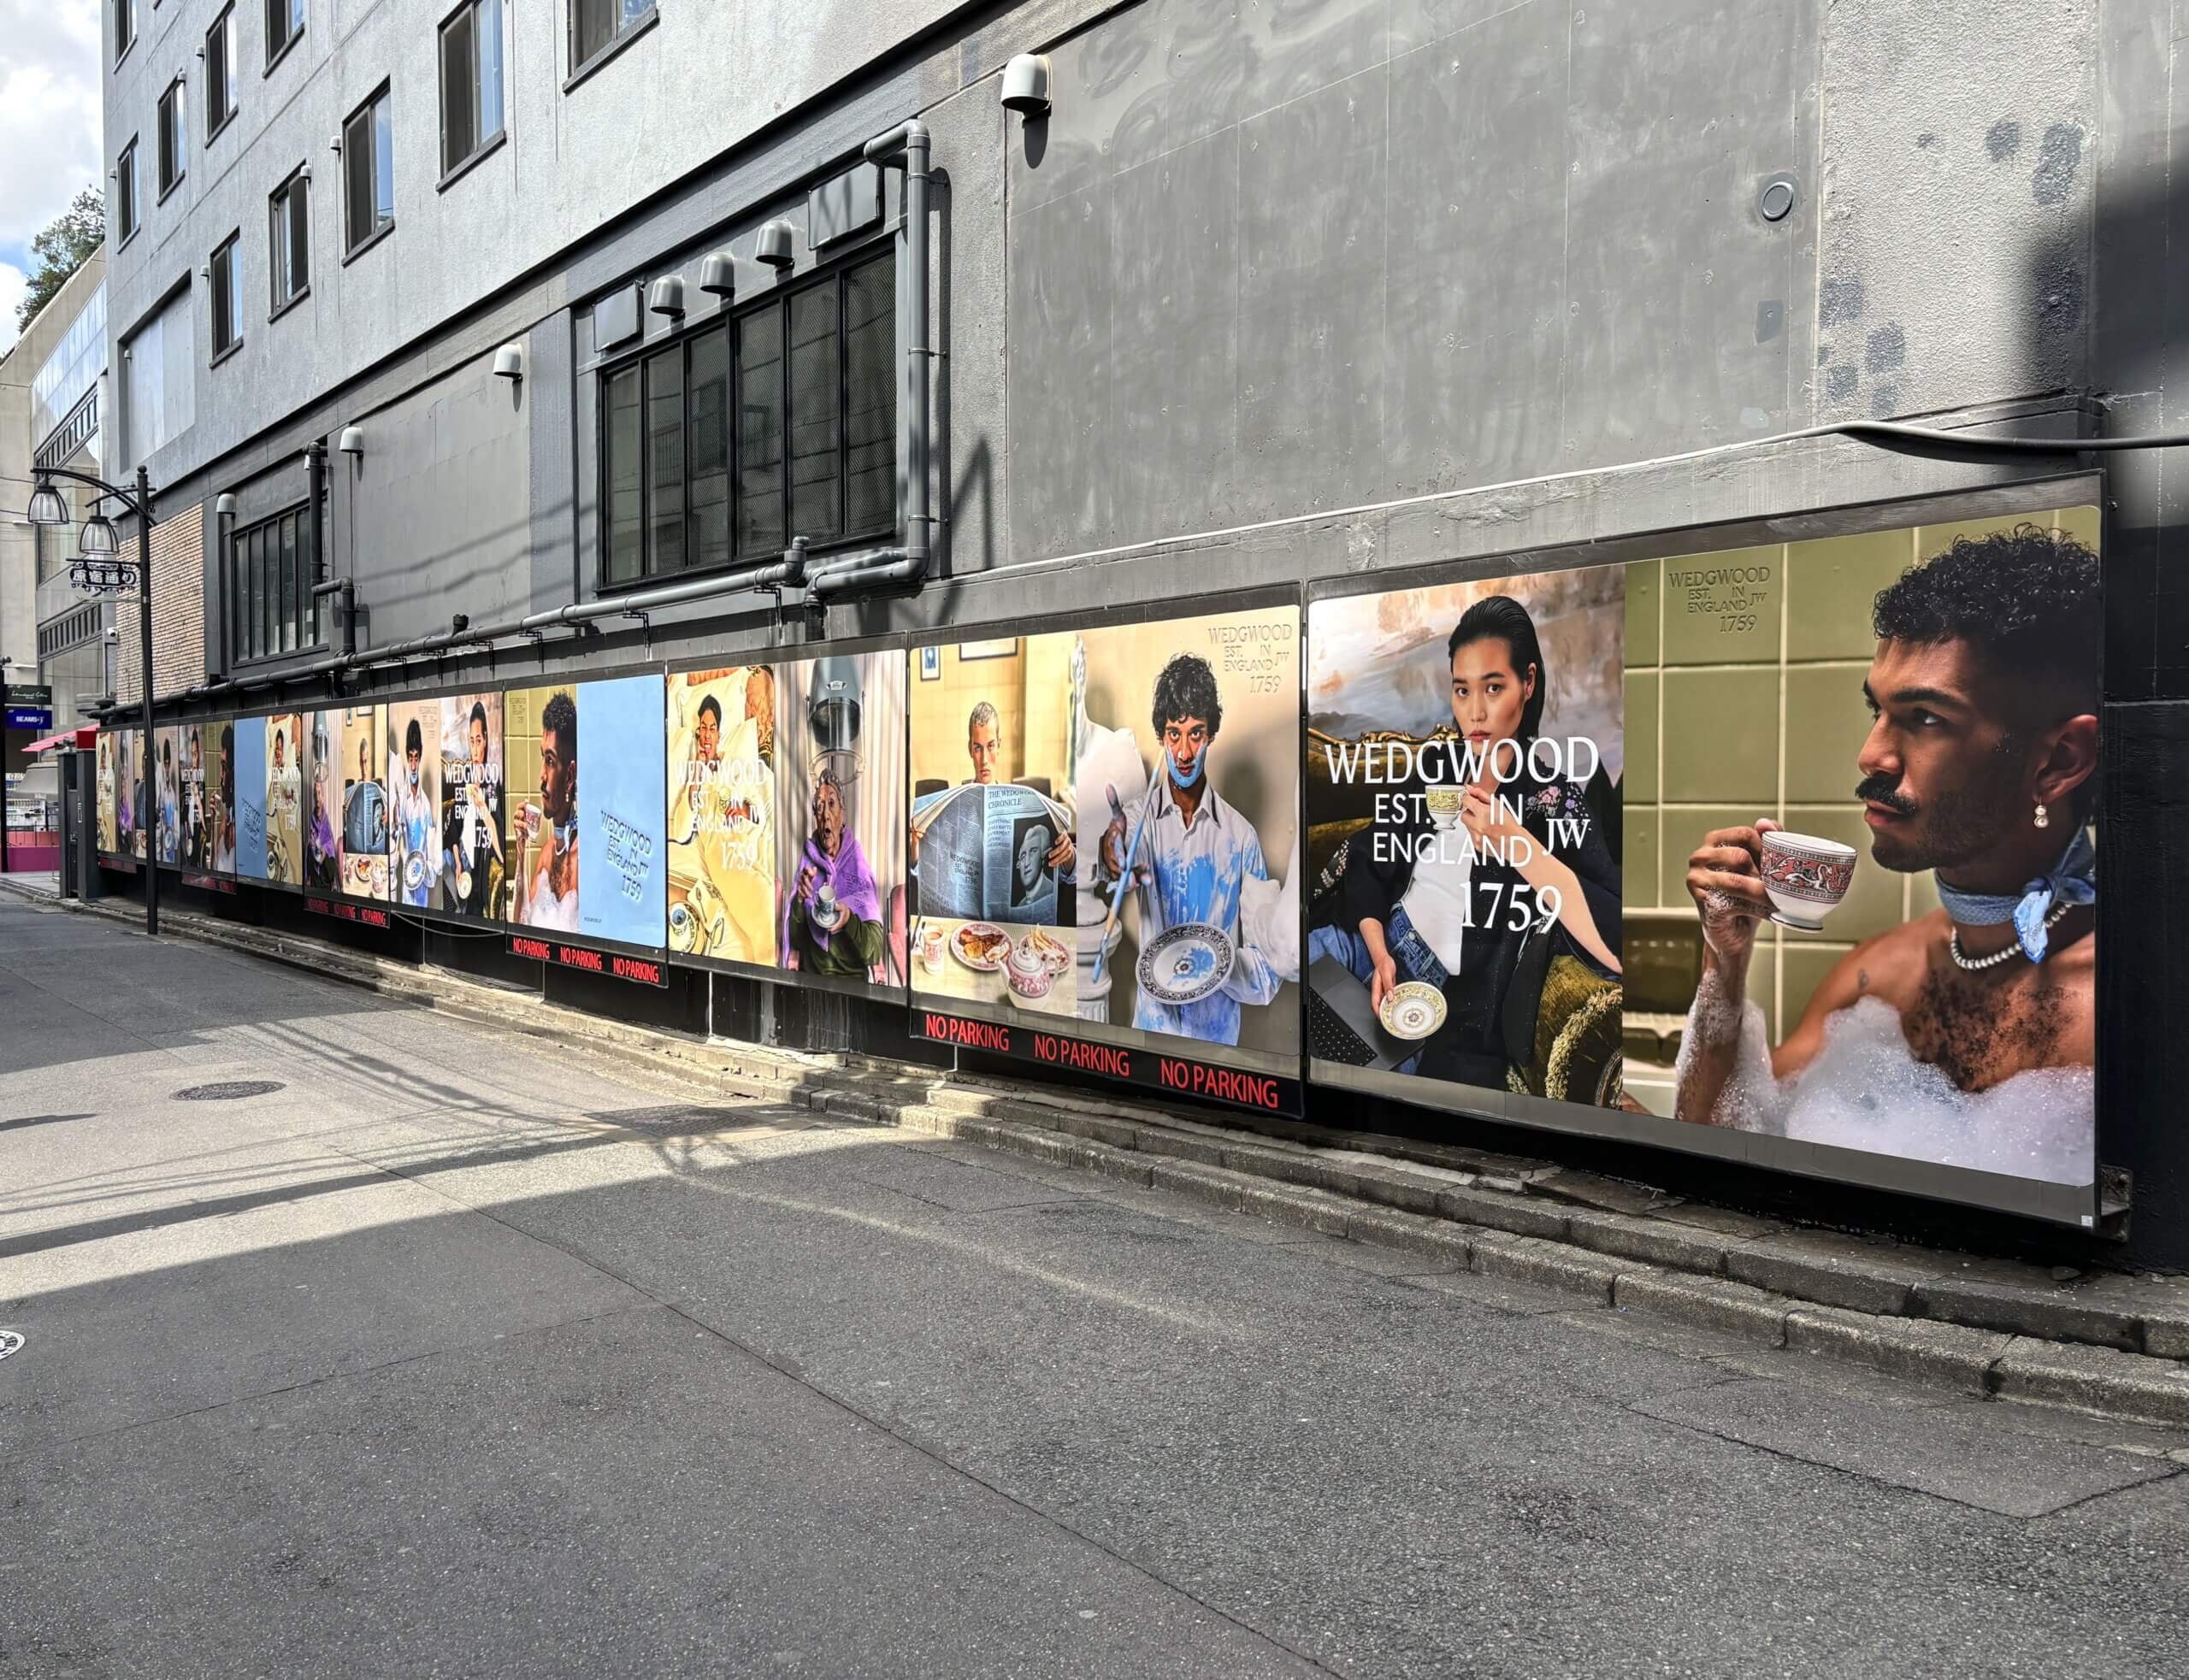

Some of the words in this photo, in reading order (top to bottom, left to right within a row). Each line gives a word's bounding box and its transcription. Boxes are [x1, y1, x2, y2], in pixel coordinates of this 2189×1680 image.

[72, 569, 135, 585] 原宿通り
[1669, 567, 1771, 587] WEDGWOOD
[1689, 588, 1711, 600] EST.
[1732, 586, 1745, 598] IN
[1688, 600, 1748, 613] ENGLAND
[1207, 624, 1292, 644] WEDGWOOD
[1720, 615, 1757, 632] 1759
[1224, 645, 1243, 657] EST.
[1260, 644, 1272, 657] IN
[1224, 658, 1273, 672] ENGLAND
[1250, 675, 1282, 693] 1759
[676, 758, 768, 785] WEDGWOOD
[1325, 735, 1601, 785] WEDGWOOD
[445, 763, 499, 784] WEDGWOOD
[988, 790, 1000, 799] THE
[988, 798, 1023, 810] CHRONICLE
[1374, 793, 1431, 824] EST.
[1490, 793, 1524, 826] IN
[600, 810, 652, 856] WEDGWOOD
[1372, 832, 1533, 868] ENGLAND
[1542, 817, 1590, 856] JW
[607, 849, 638, 877] ENGLAND
[721, 840, 757, 870] 1759
[621, 875, 643, 902] 1759
[1459, 881, 1563, 934] 1759
[512, 937, 522, 953] NO
[522, 940, 551, 959] PARKING
[560, 946, 572, 964] NO
[572, 950, 602, 970] PARKING
[613, 957, 625, 976] NO
[625, 959, 659, 983] PARKING
[925, 1013, 947, 1040] NO
[949, 1018, 1010, 1052] PARKING
[1035, 1034, 1058, 1061] NO
[1060, 1040, 1130, 1077] PARKING
[1159, 1058, 1189, 1088] NO
[1194, 1065, 1278, 1109] PARKING
